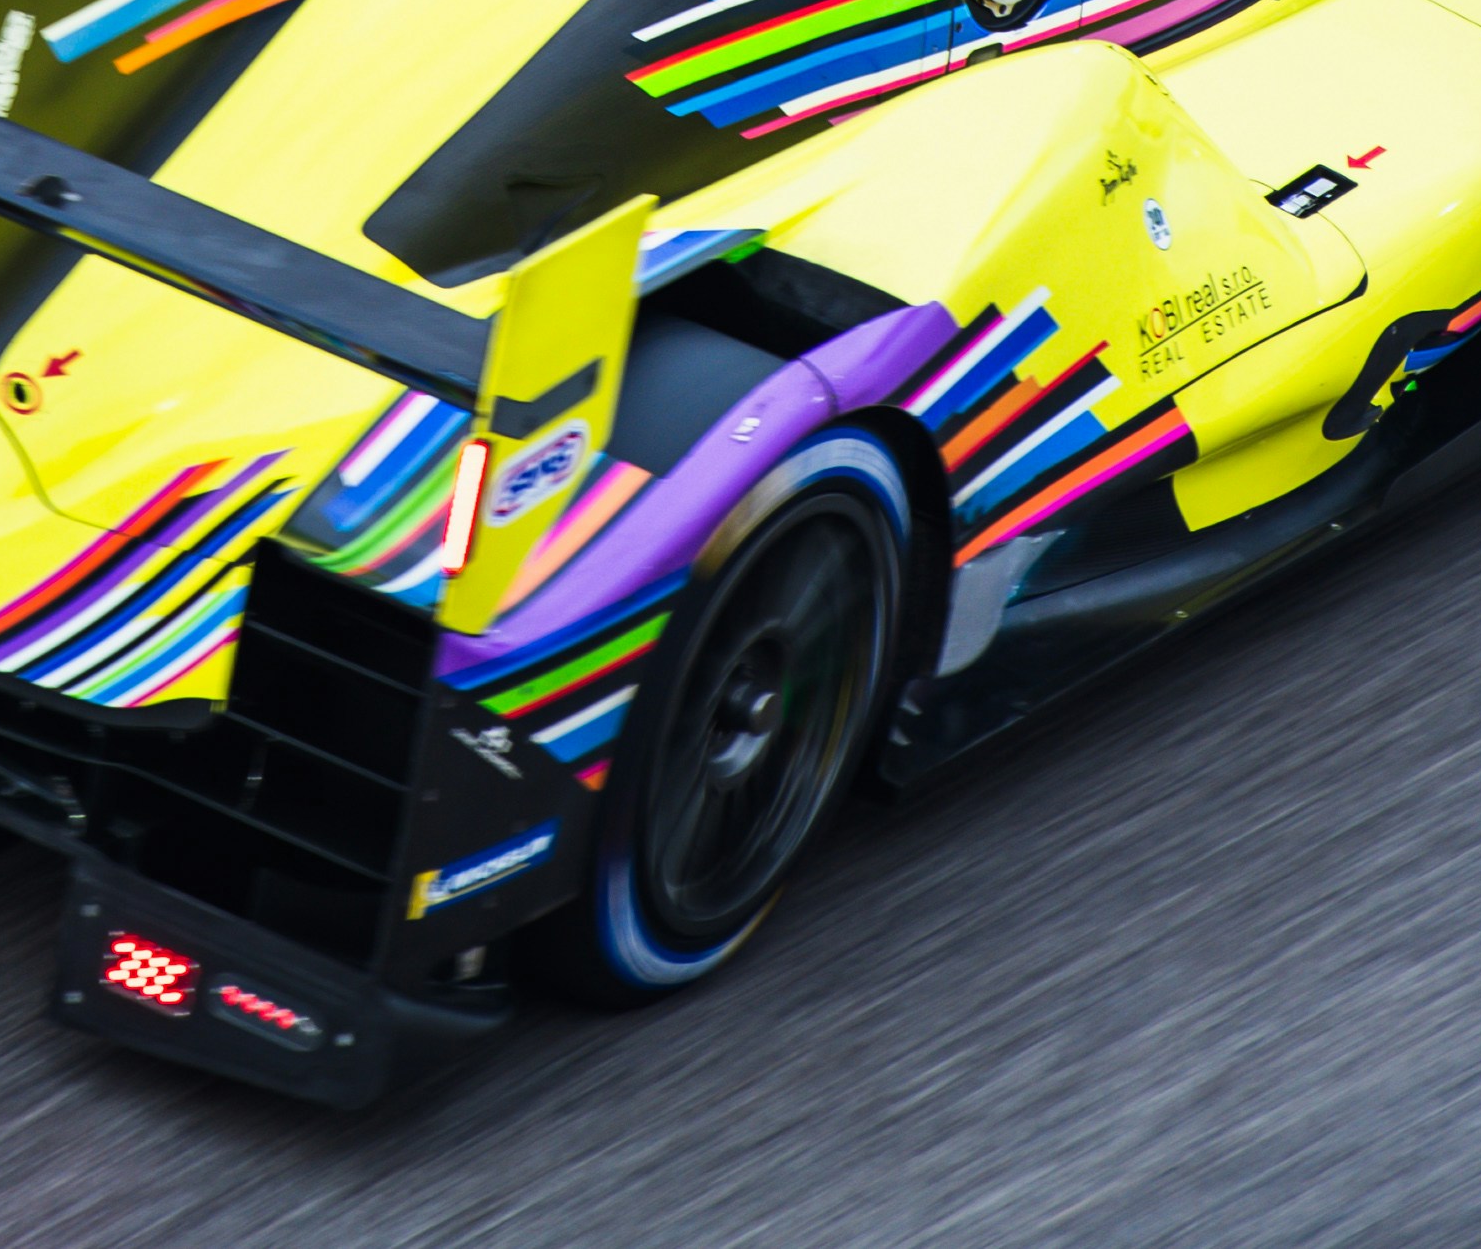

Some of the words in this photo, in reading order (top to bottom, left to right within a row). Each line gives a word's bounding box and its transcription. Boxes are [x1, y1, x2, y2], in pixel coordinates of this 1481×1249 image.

[1137, 295, 1184, 349] KOBI
[1186, 272, 1220, 319] real
[1140, 341, 1185, 383] REAL
[1201, 287, 1272, 343] ESTATE
